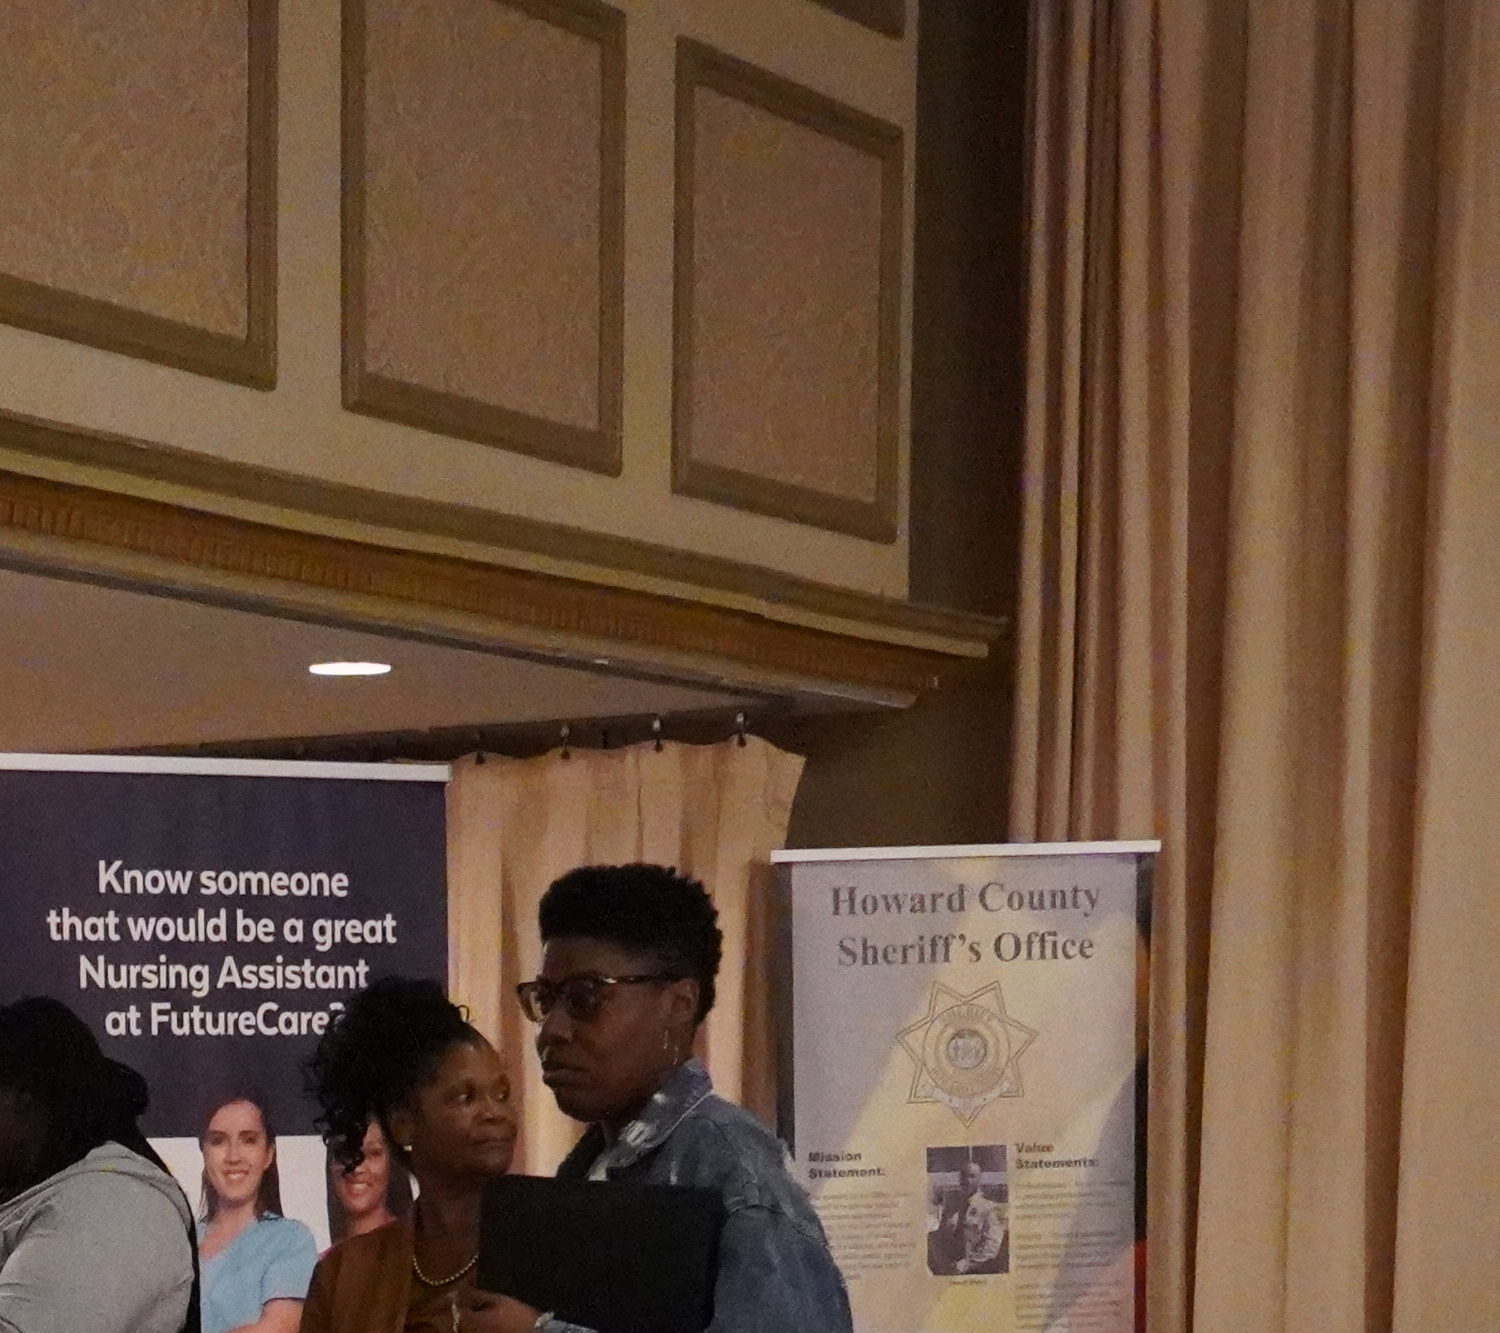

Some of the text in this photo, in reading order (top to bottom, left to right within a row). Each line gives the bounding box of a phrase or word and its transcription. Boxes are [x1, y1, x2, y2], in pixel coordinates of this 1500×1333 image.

[98, 859, 350, 898] Know someone
[831, 881, 1100, 918] Howard County
[47, 908, 398, 951] that would be a great
[993, 930, 1095, 962] Office
[79, 955, 370, 997] Nursing Assistant
[104, 1005, 142, 1037] at
[808, 1151, 862, 1163] Mission
[1015, 1142, 1055, 1154] Value
